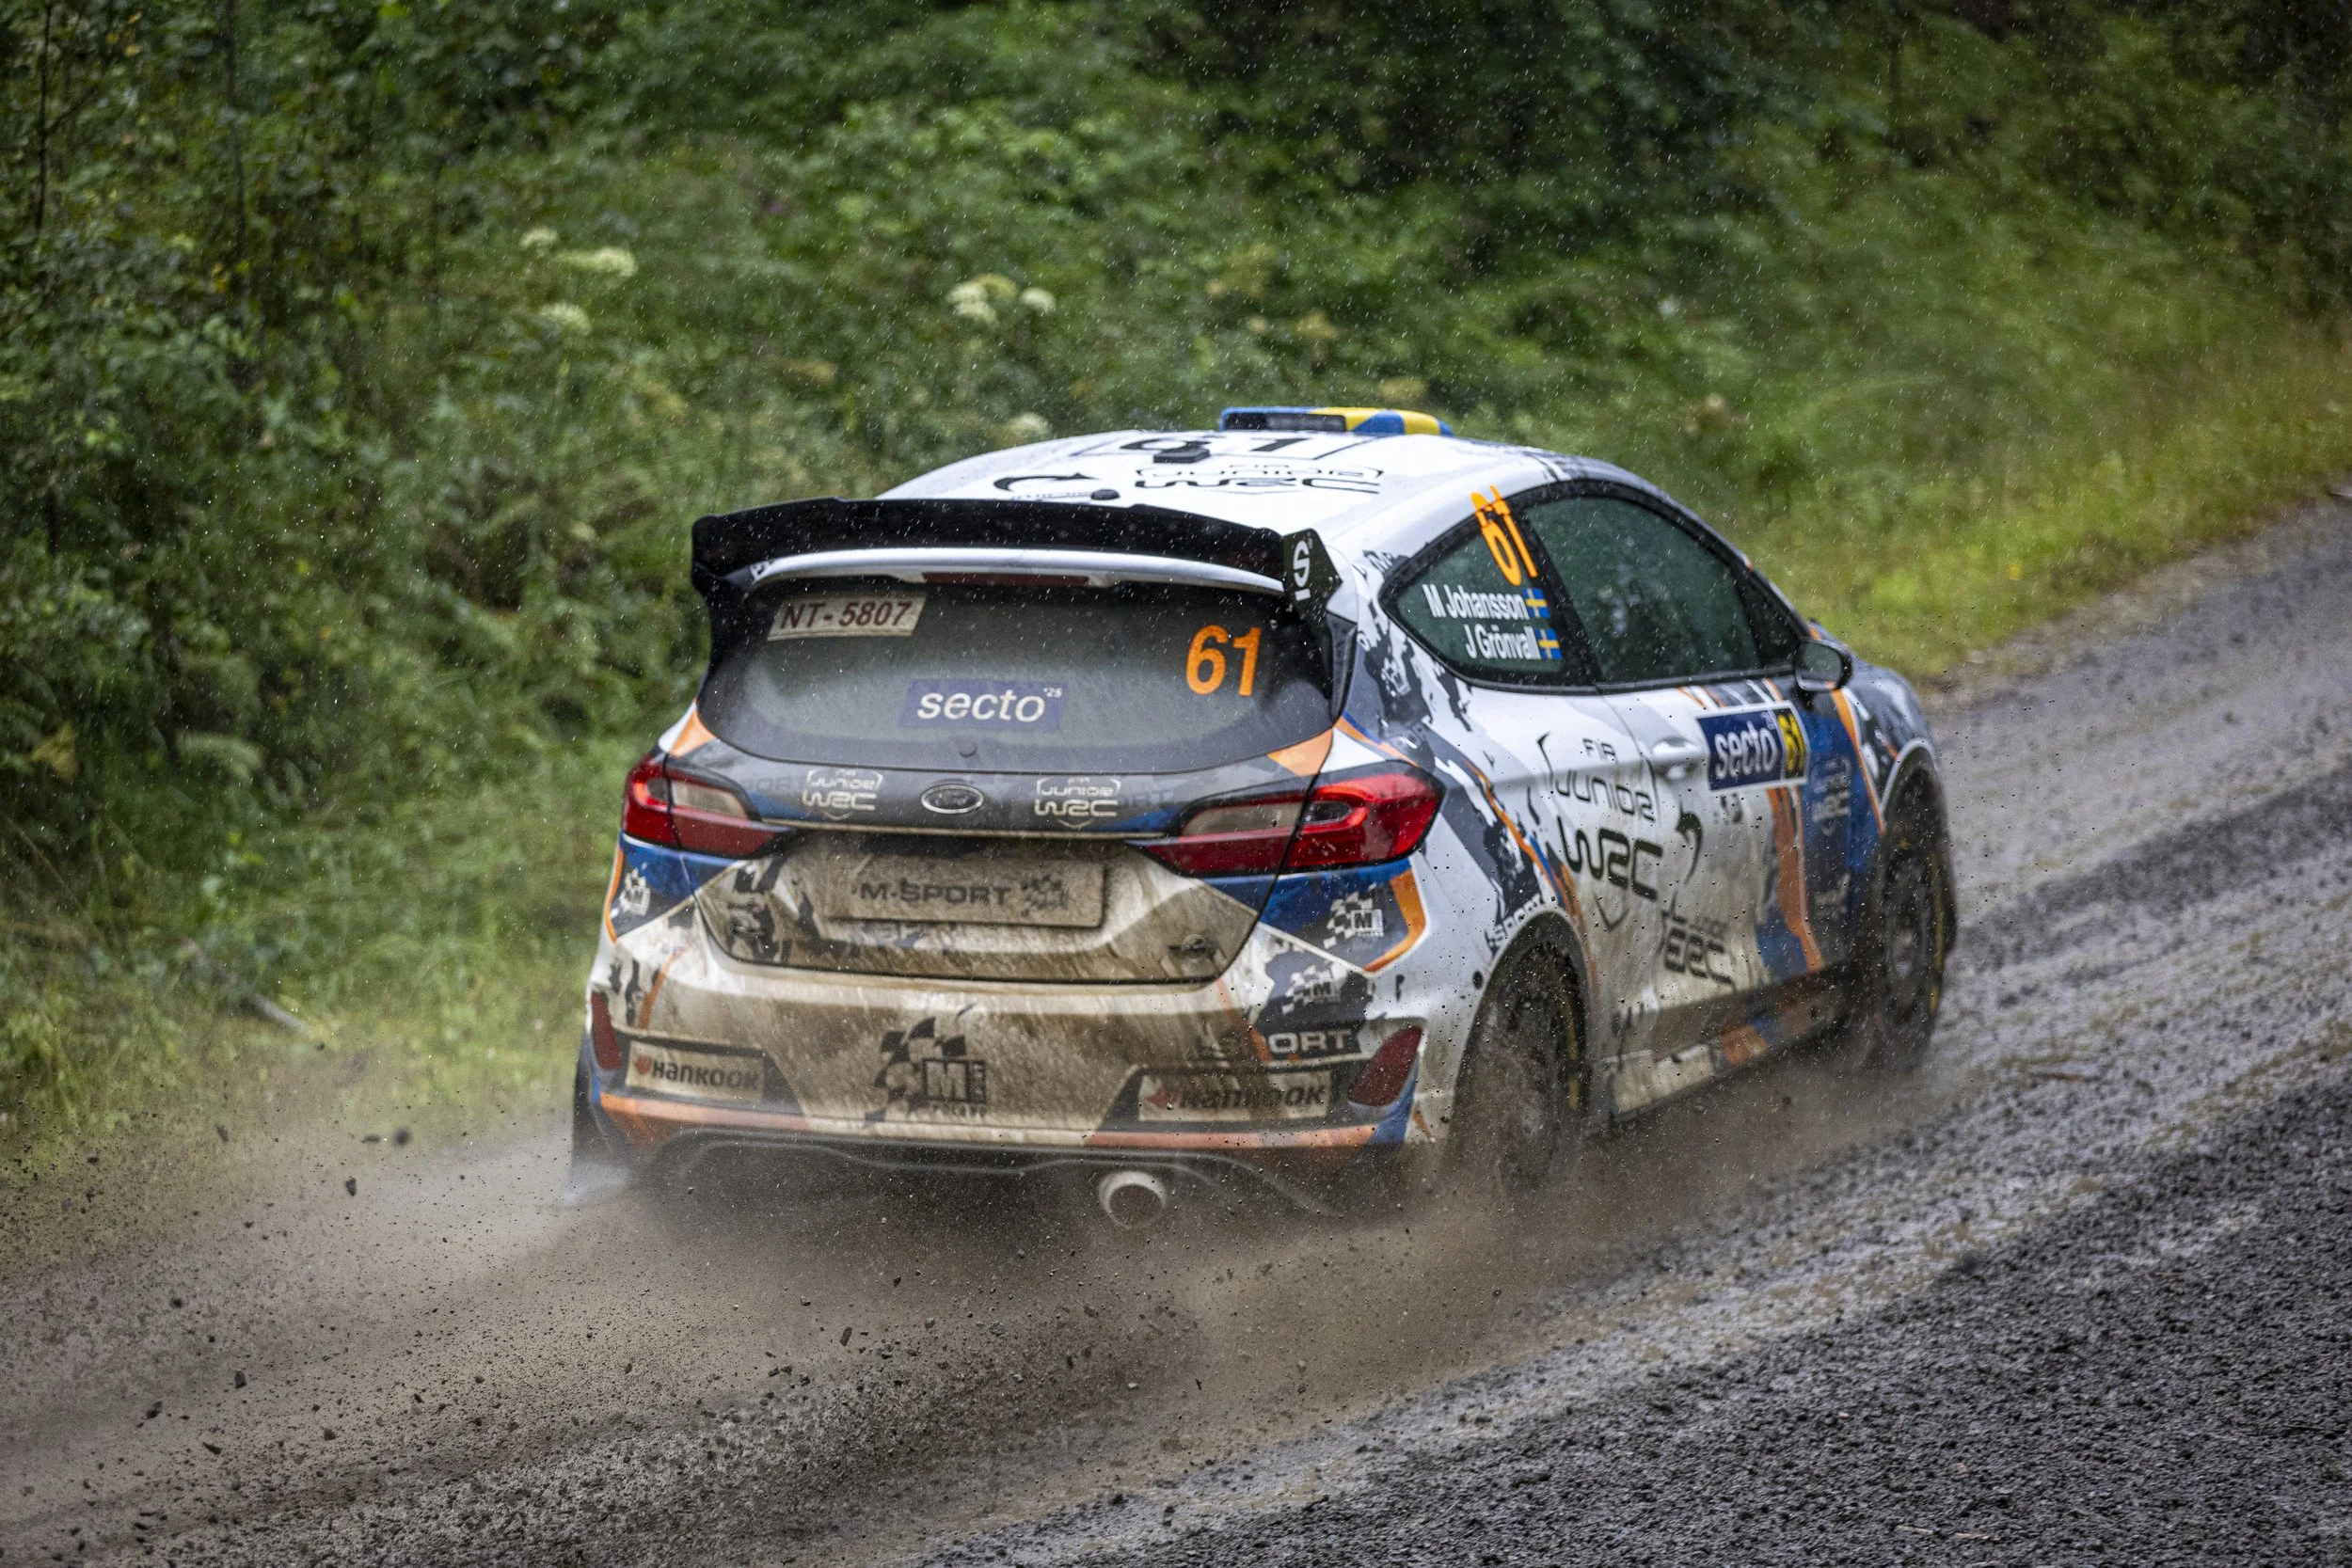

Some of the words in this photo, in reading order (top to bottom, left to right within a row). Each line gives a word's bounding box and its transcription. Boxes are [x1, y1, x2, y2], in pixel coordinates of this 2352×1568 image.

[1470, 484, 1539, 587] 61
[1422, 583, 1447, 618] M
[1443, 584, 1530, 620] Johansson
[1185, 624, 1262, 697] 61
[1463, 624, 1478, 659] J
[1474, 624, 1542, 660] Grönvall
[917, 689, 1046, 722] secto
[1713, 720, 1779, 780] secto
[1034, 799, 1120, 817] WRC
[1556, 815, 1664, 902] WRC
